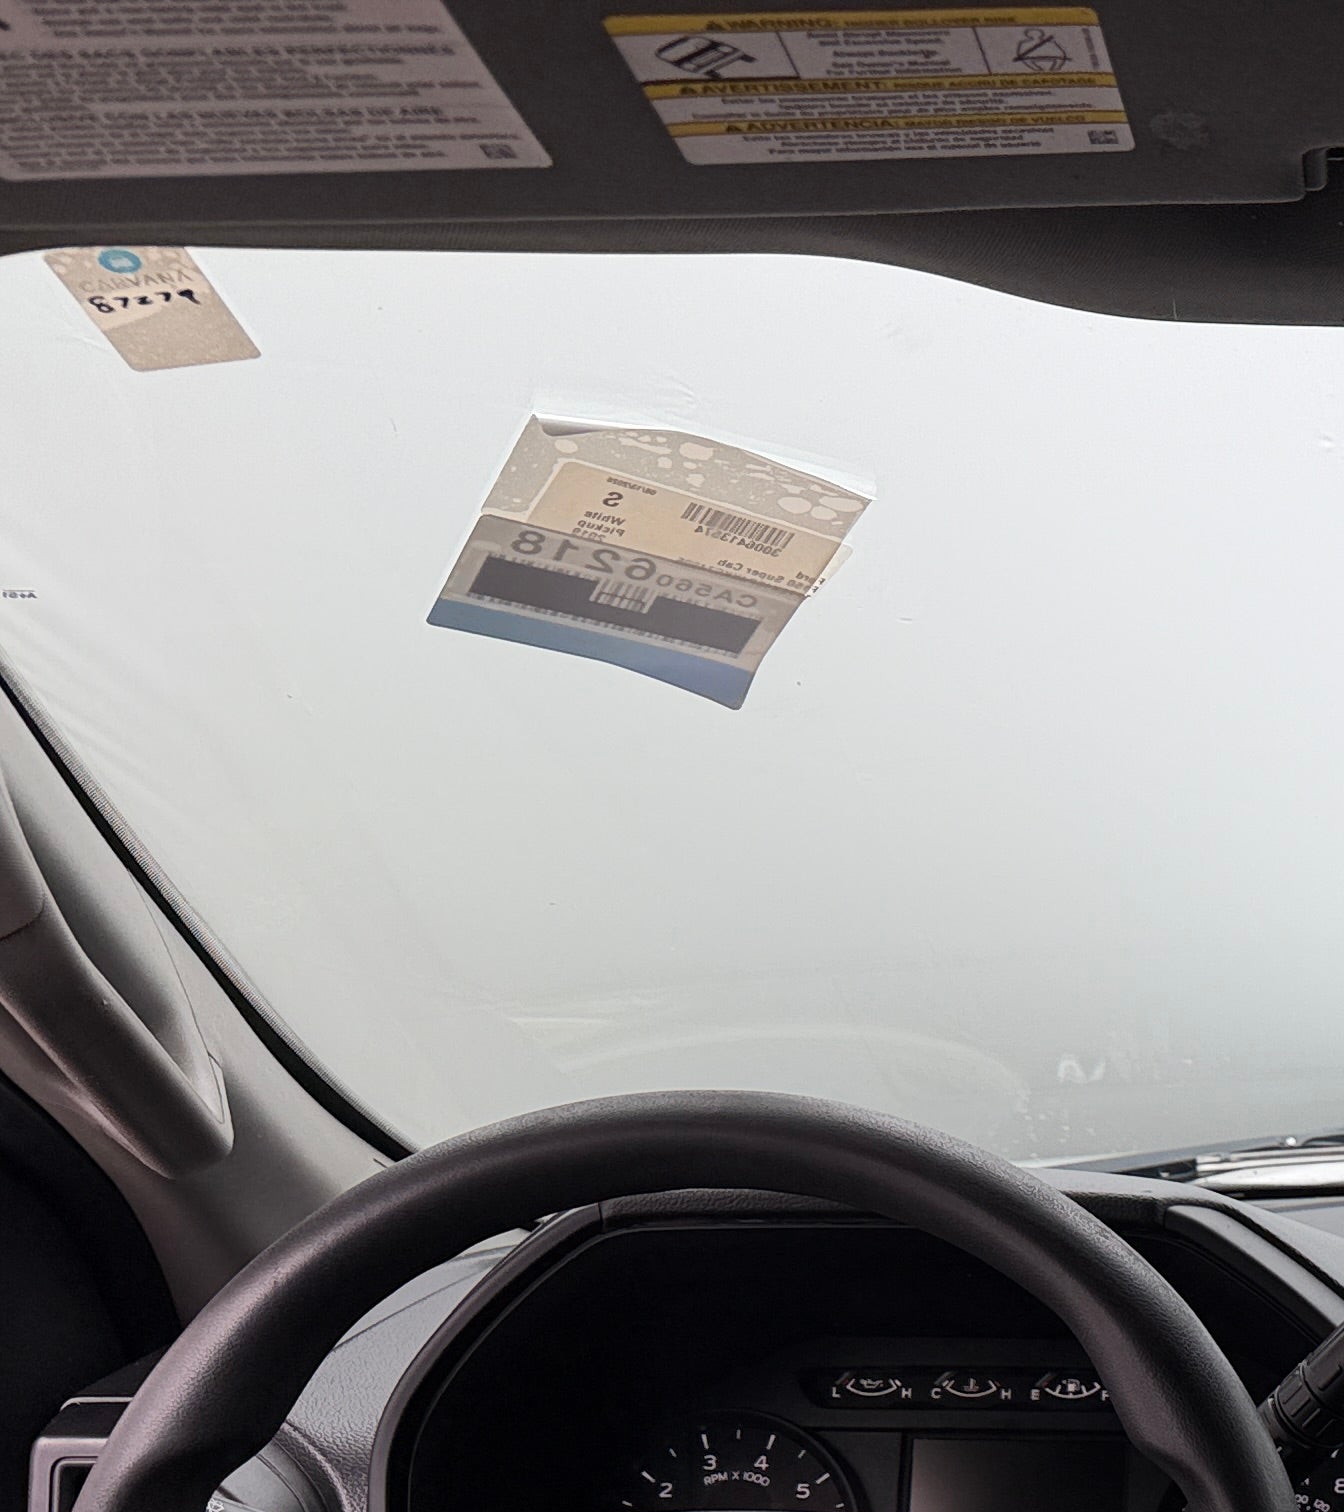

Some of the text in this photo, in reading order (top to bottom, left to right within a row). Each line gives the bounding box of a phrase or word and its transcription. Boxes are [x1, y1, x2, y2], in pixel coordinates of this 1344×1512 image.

[78, 270, 194, 294] CARVANA
[831, 1386, 912, 1398] L H
[930, 1387, 1012, 1400] C H
[1030, 1388, 1040, 1401] E
[702, 1454, 718, 1471] 3
[753, 1455, 771, 1472] 4
[703, 1472, 730, 1487] RPM
[742, 1472, 770, 1486] 1000
[658, 1482, 673, 1498] 2
[795, 1483, 811, 1499] 5
[1295, 1494, 1309, 1504] 00
[1313, 1499, 1330, 1512] 120
